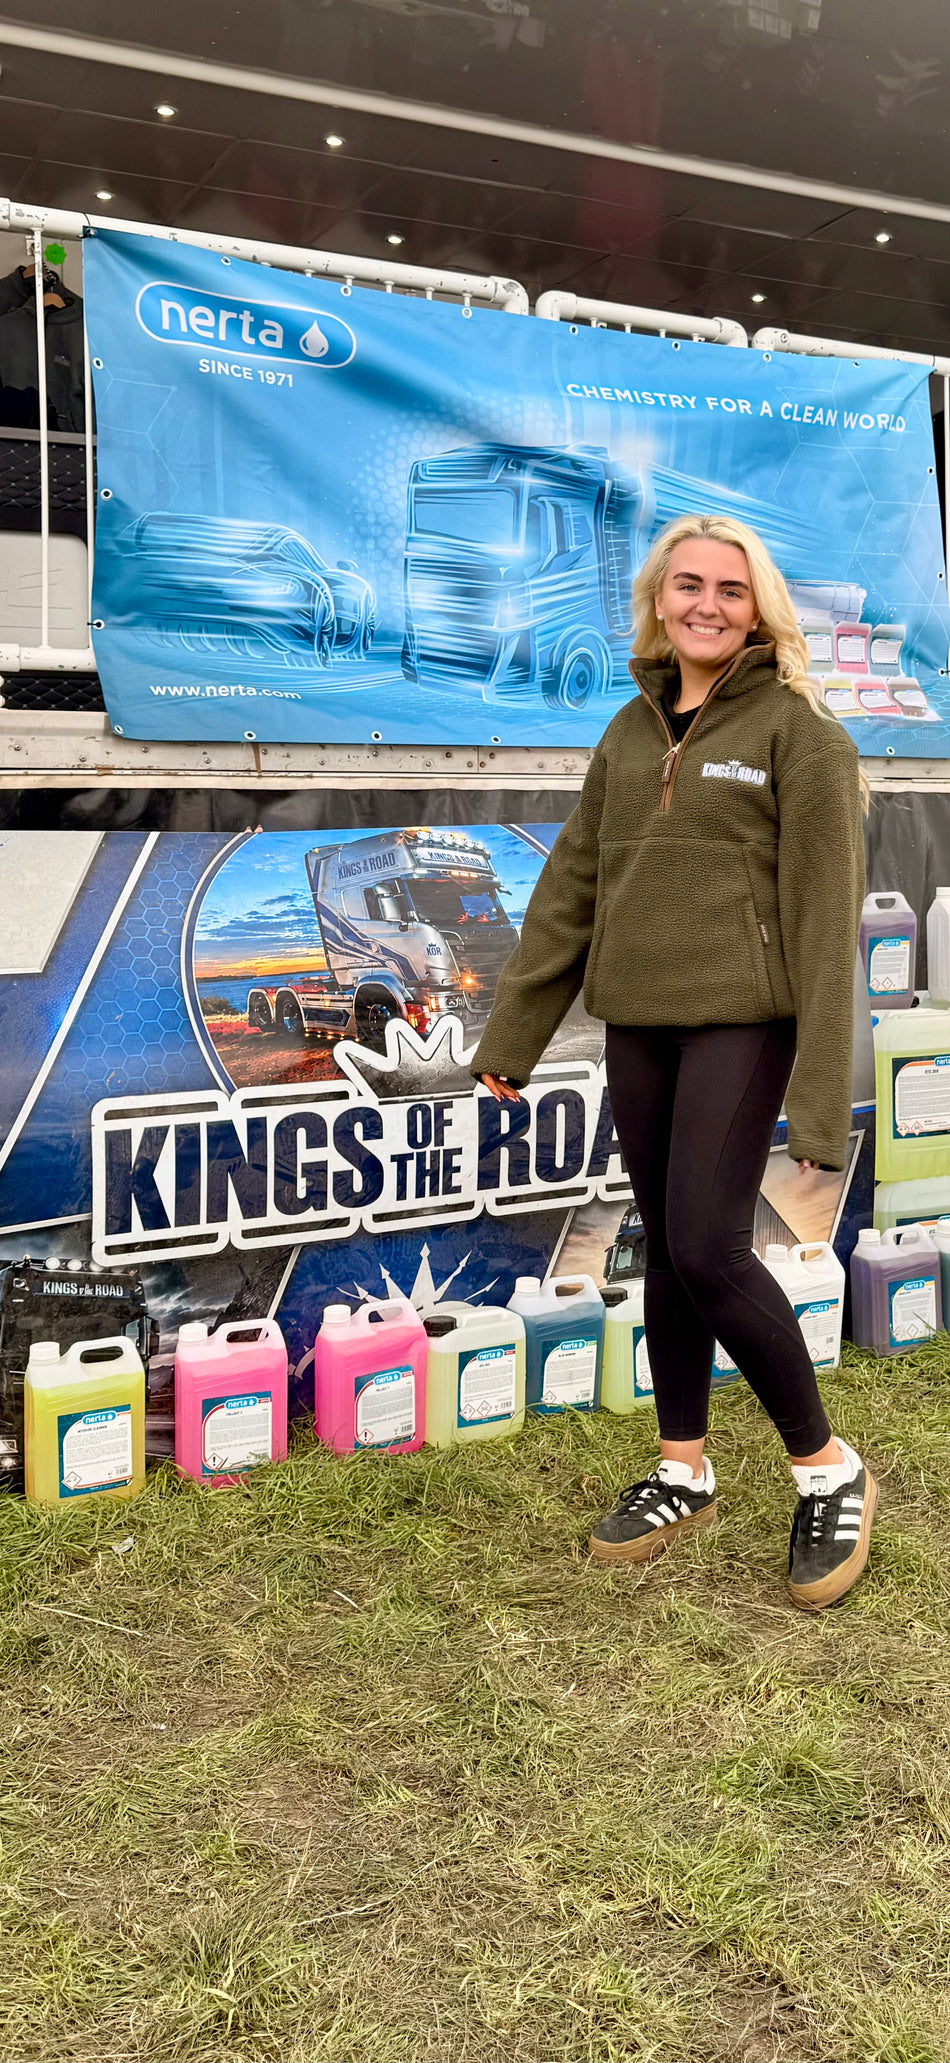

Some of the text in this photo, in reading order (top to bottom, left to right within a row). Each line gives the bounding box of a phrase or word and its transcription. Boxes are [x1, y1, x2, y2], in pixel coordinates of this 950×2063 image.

[160, 298, 284, 349] nerta
[198, 358, 294, 388] SINCE 1971
[566, 383, 906, 432] CHEMISTRY FOR A CLEAN WORLD
[149, 684, 302, 700] www.nerta.com
[338, 862, 362, 879] KINGS
[369, 852, 396, 871] ROAD
[104, 1086, 632, 1235] KINGS OF THE ROA
[43, 1281, 78, 1294] KINGS
[95, 1284, 124, 1297] ROAD
[227, 1399, 248, 1409] nerta
[85, 1413, 107, 1424] nerta
